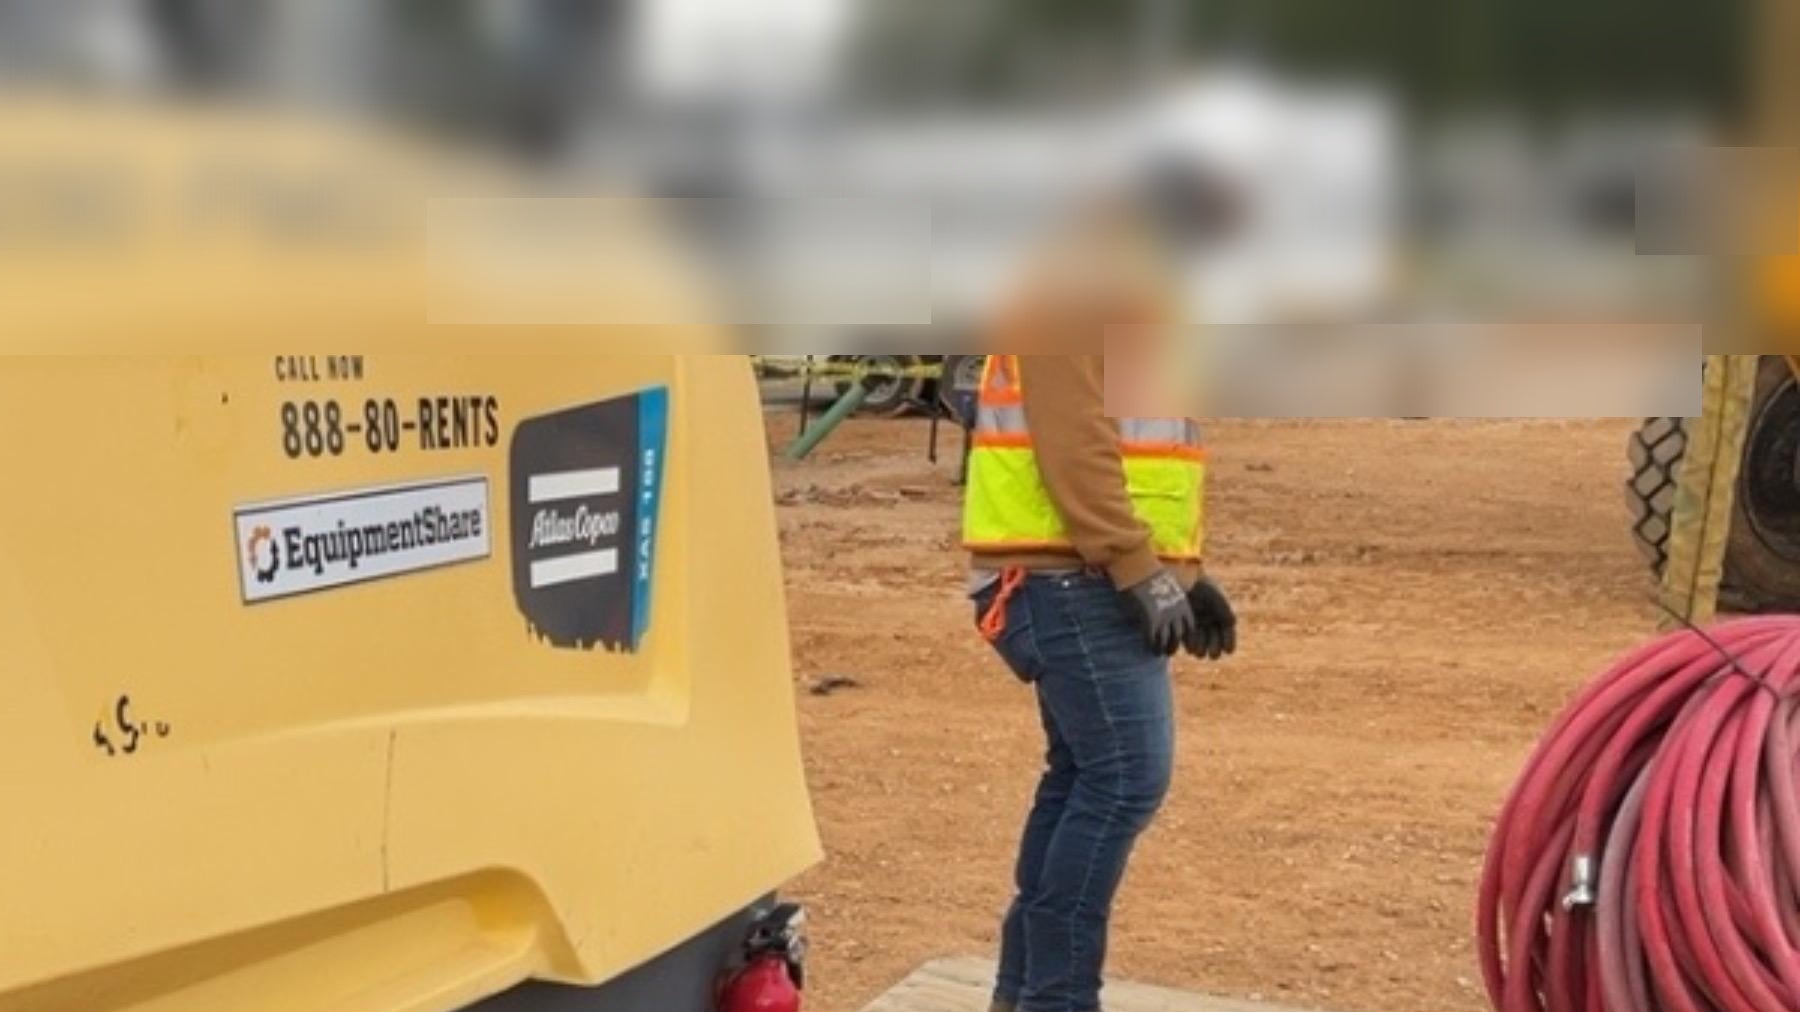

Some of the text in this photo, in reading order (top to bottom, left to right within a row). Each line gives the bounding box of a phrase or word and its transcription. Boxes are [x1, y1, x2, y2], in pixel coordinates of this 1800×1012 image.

[275, 355, 364, 381] CALL NOW
[281, 396, 499, 459] 888-80-RENTS
[282, 505, 482, 576] EquipmentShare
[528, 504, 620, 549] Atlas Copco
